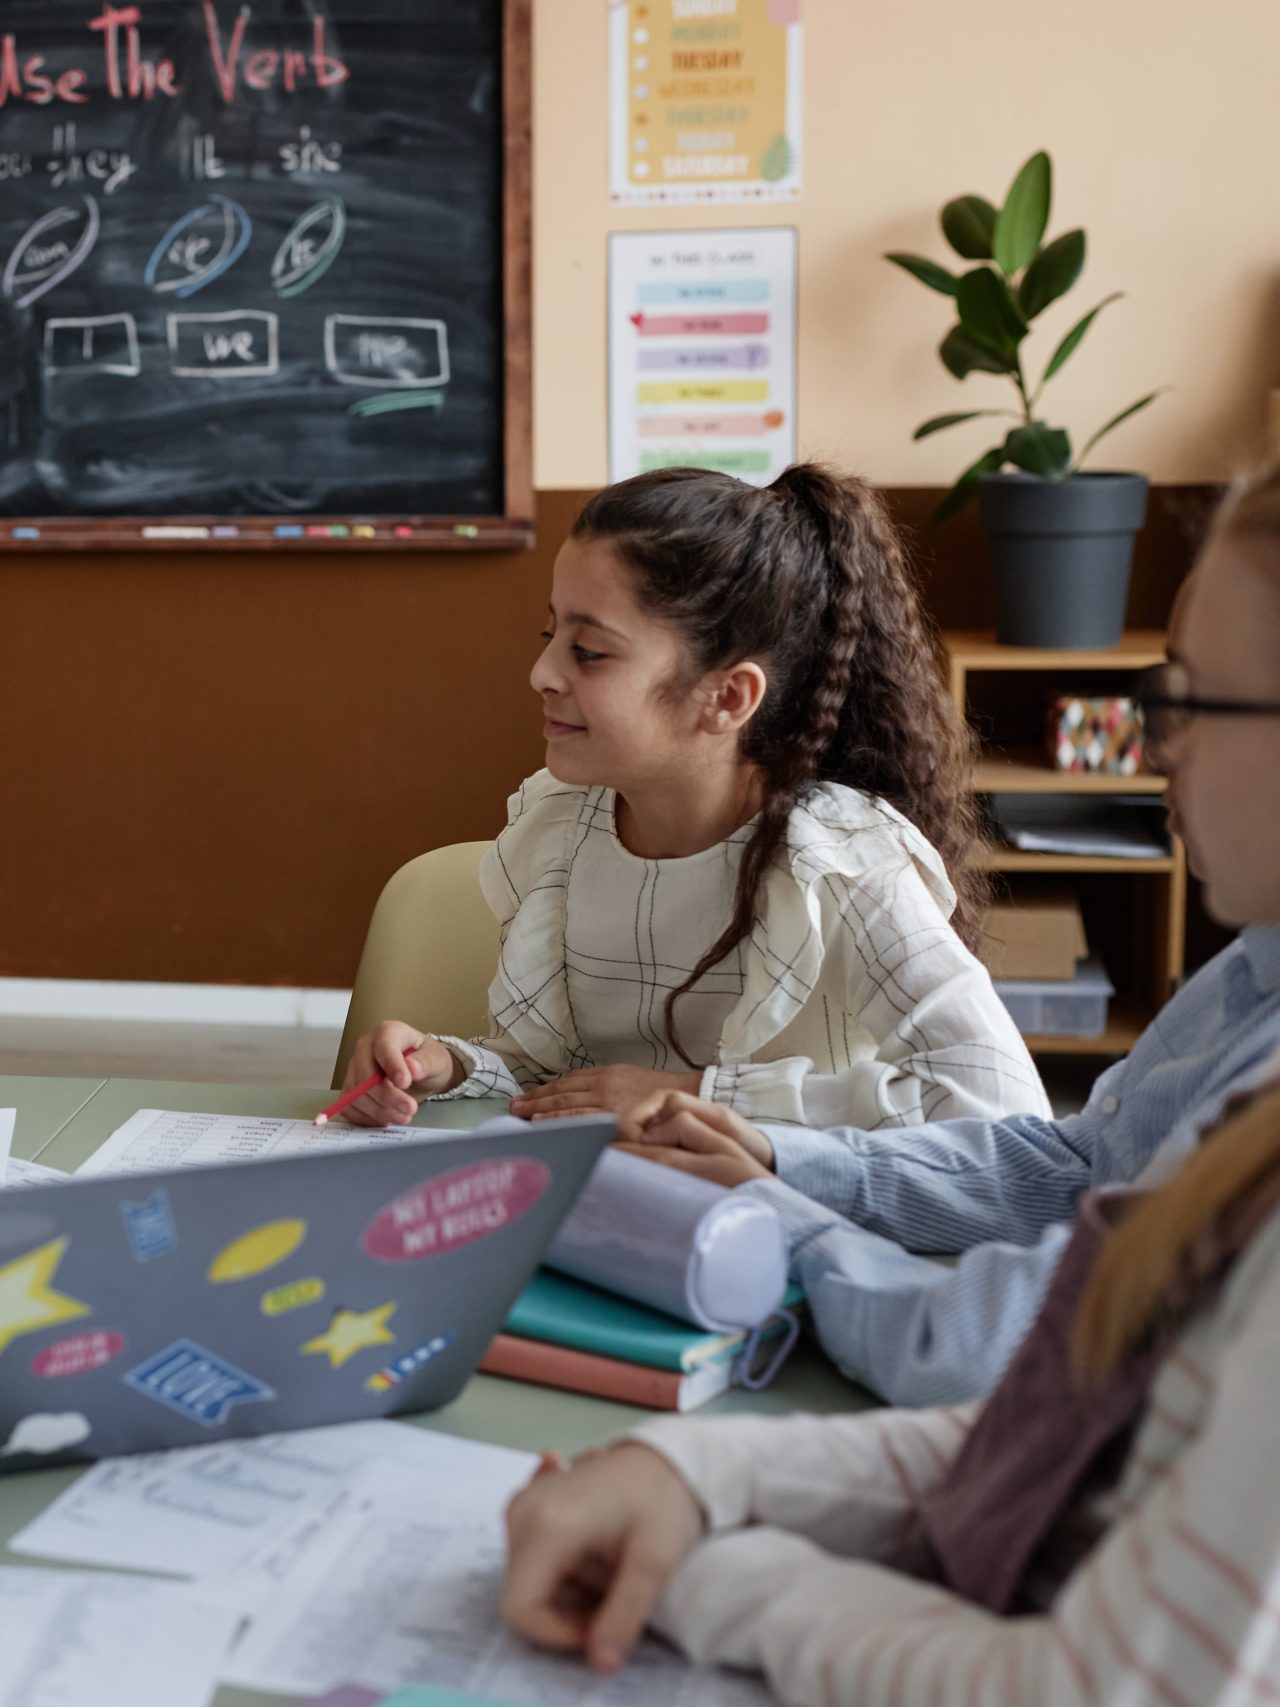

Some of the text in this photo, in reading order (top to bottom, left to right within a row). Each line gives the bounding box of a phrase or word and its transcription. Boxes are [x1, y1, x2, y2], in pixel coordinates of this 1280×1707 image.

[88, 1, 181, 98] The
[204, 0, 349, 102] Verb
[672, 51, 742, 71] TUESDAY
[203, 329, 254, 361] we
